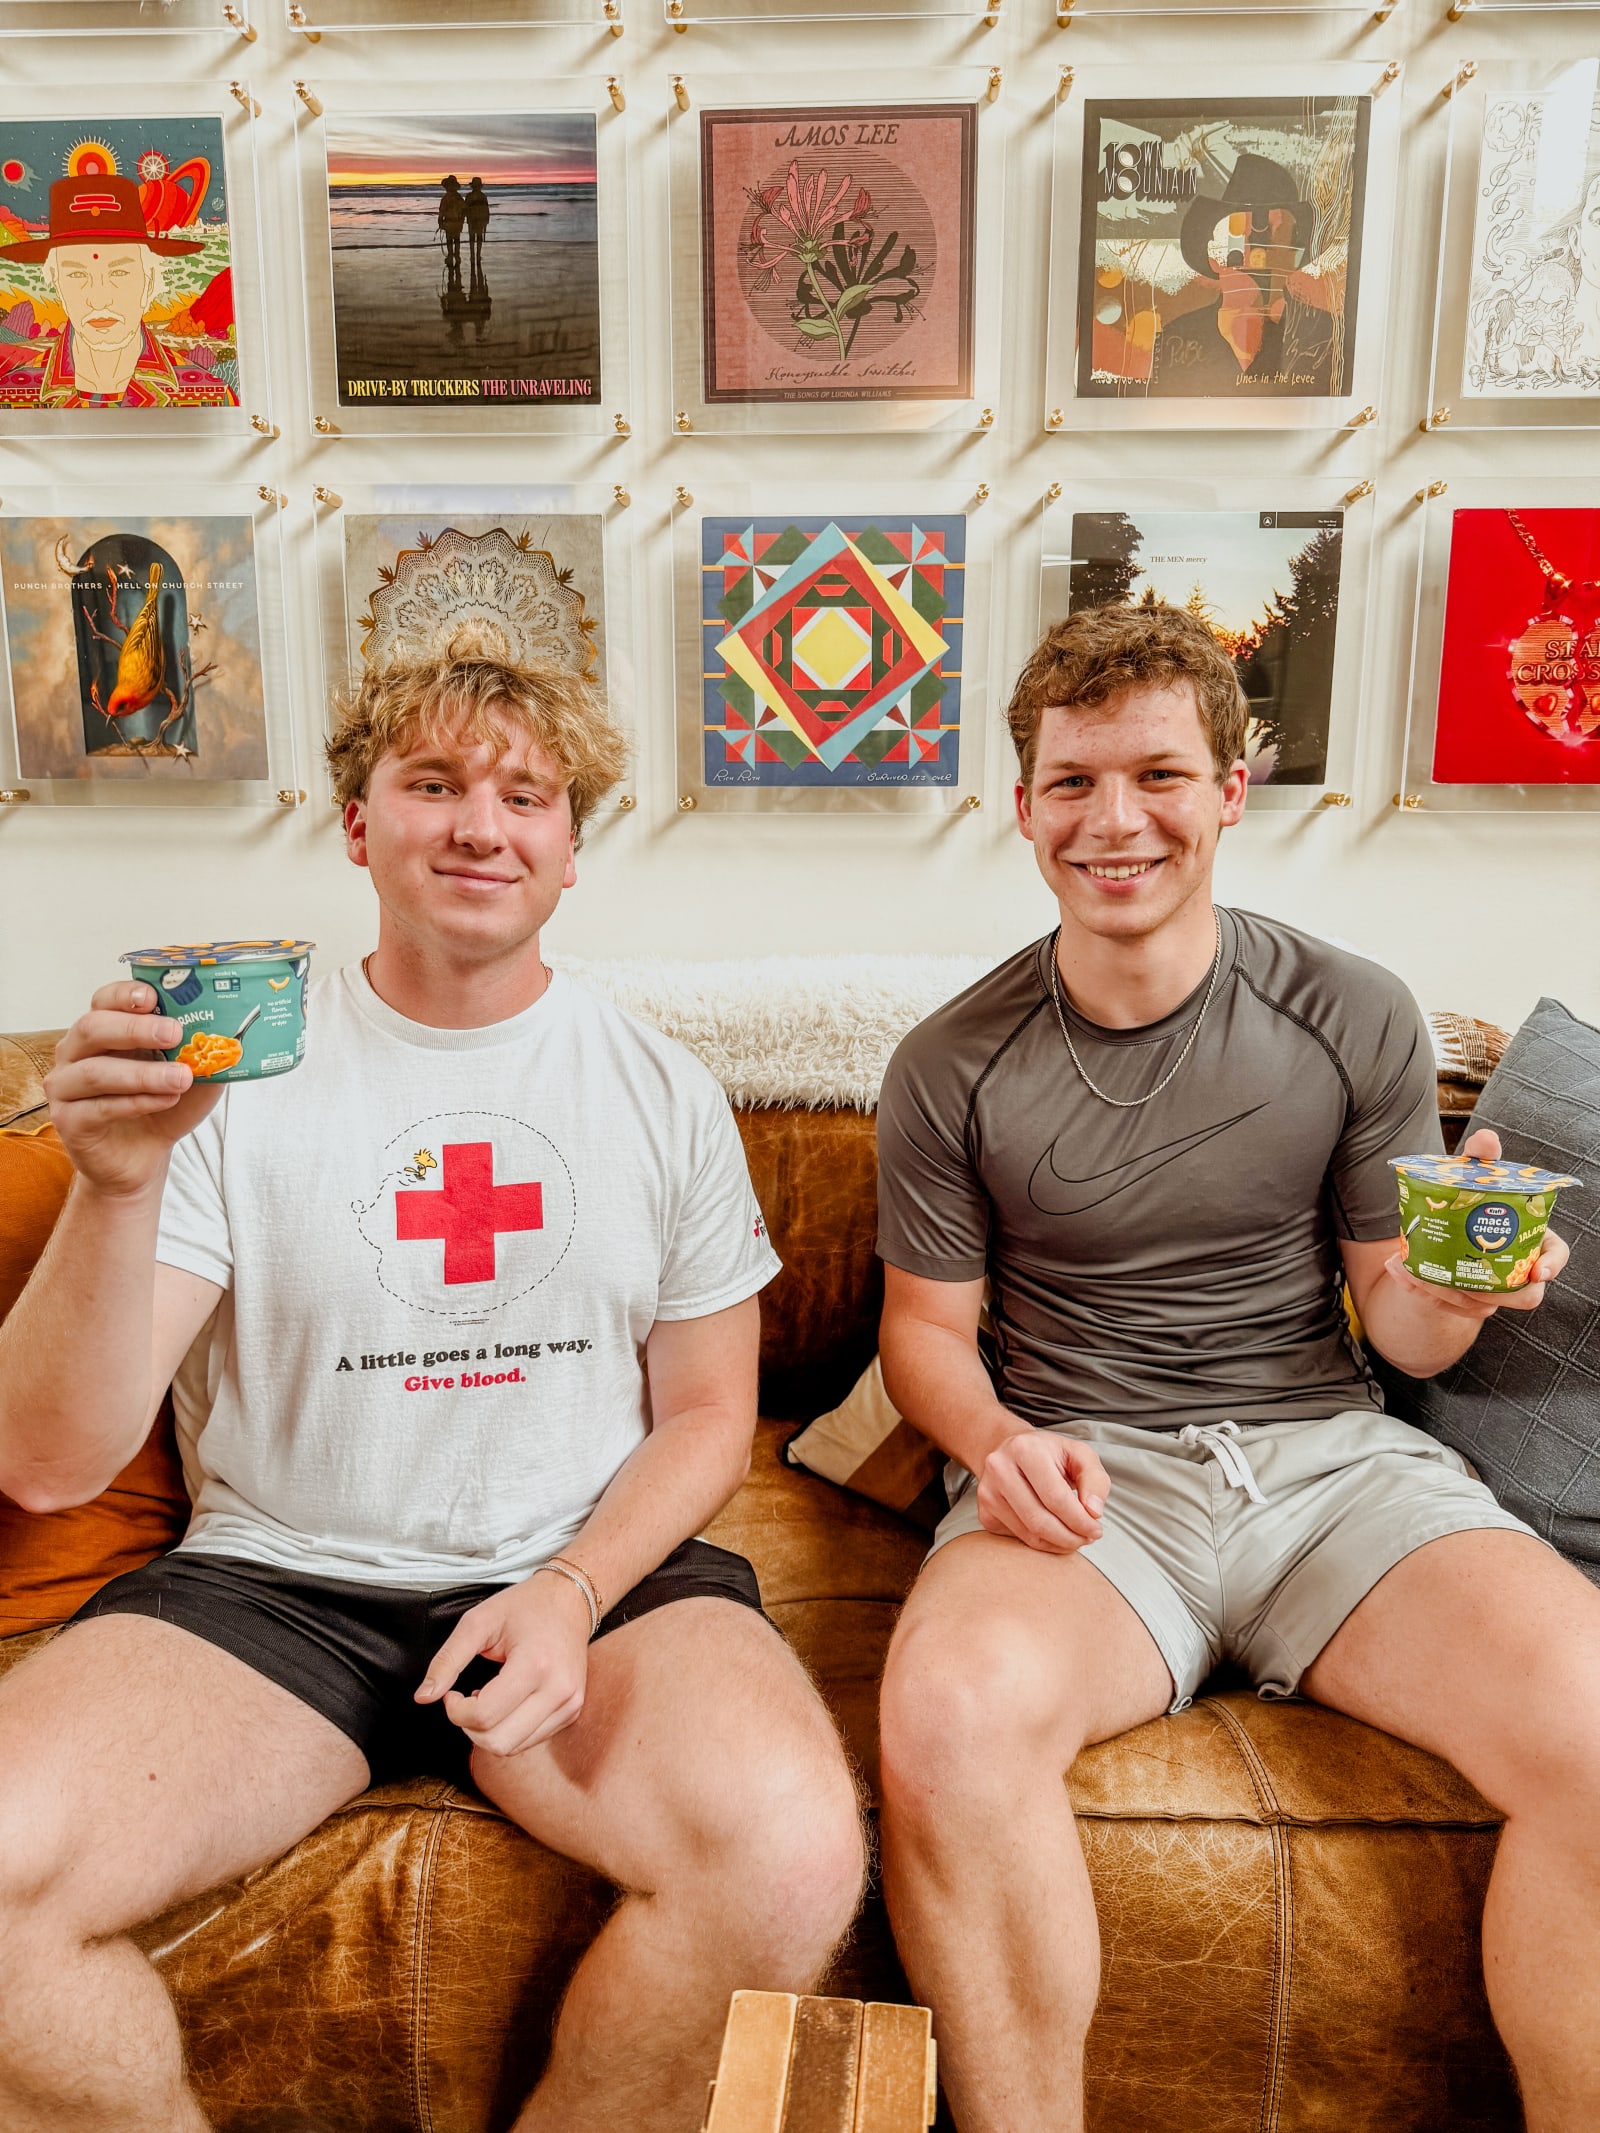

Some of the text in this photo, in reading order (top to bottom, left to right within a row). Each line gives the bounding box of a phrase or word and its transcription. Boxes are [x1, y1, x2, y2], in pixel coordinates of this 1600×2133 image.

[774, 123, 899, 147] AMOS LEE
[1109, 141, 1164, 169] TOWN
[1104, 167, 1197, 195] MOUNTAIN
[765, 360, 917, 384] Honeysuckle Switches
[1261, 372, 1270, 384] in
[1273, 370, 1289, 384] the
[348, 378, 592, 397] DRIVE-BY TRUCKERS THE UNRAVELING
[797, 391, 820, 399] SONGS
[861, 390, 892, 398] WILLIAMS
[1186, 557, 1208, 565] mercy
[14, 582, 244, 590] PUNCH BROTHERS HELL ON CHURCH STREET
[1545, 640, 1600, 658] STA
[177, 1009, 214, 1026] RANCH
[1488, 1207, 1503, 1215] Kraft
[336, 1338, 593, 1372] A little goes a long way.
[404, 1367, 527, 1392] Give blood.
